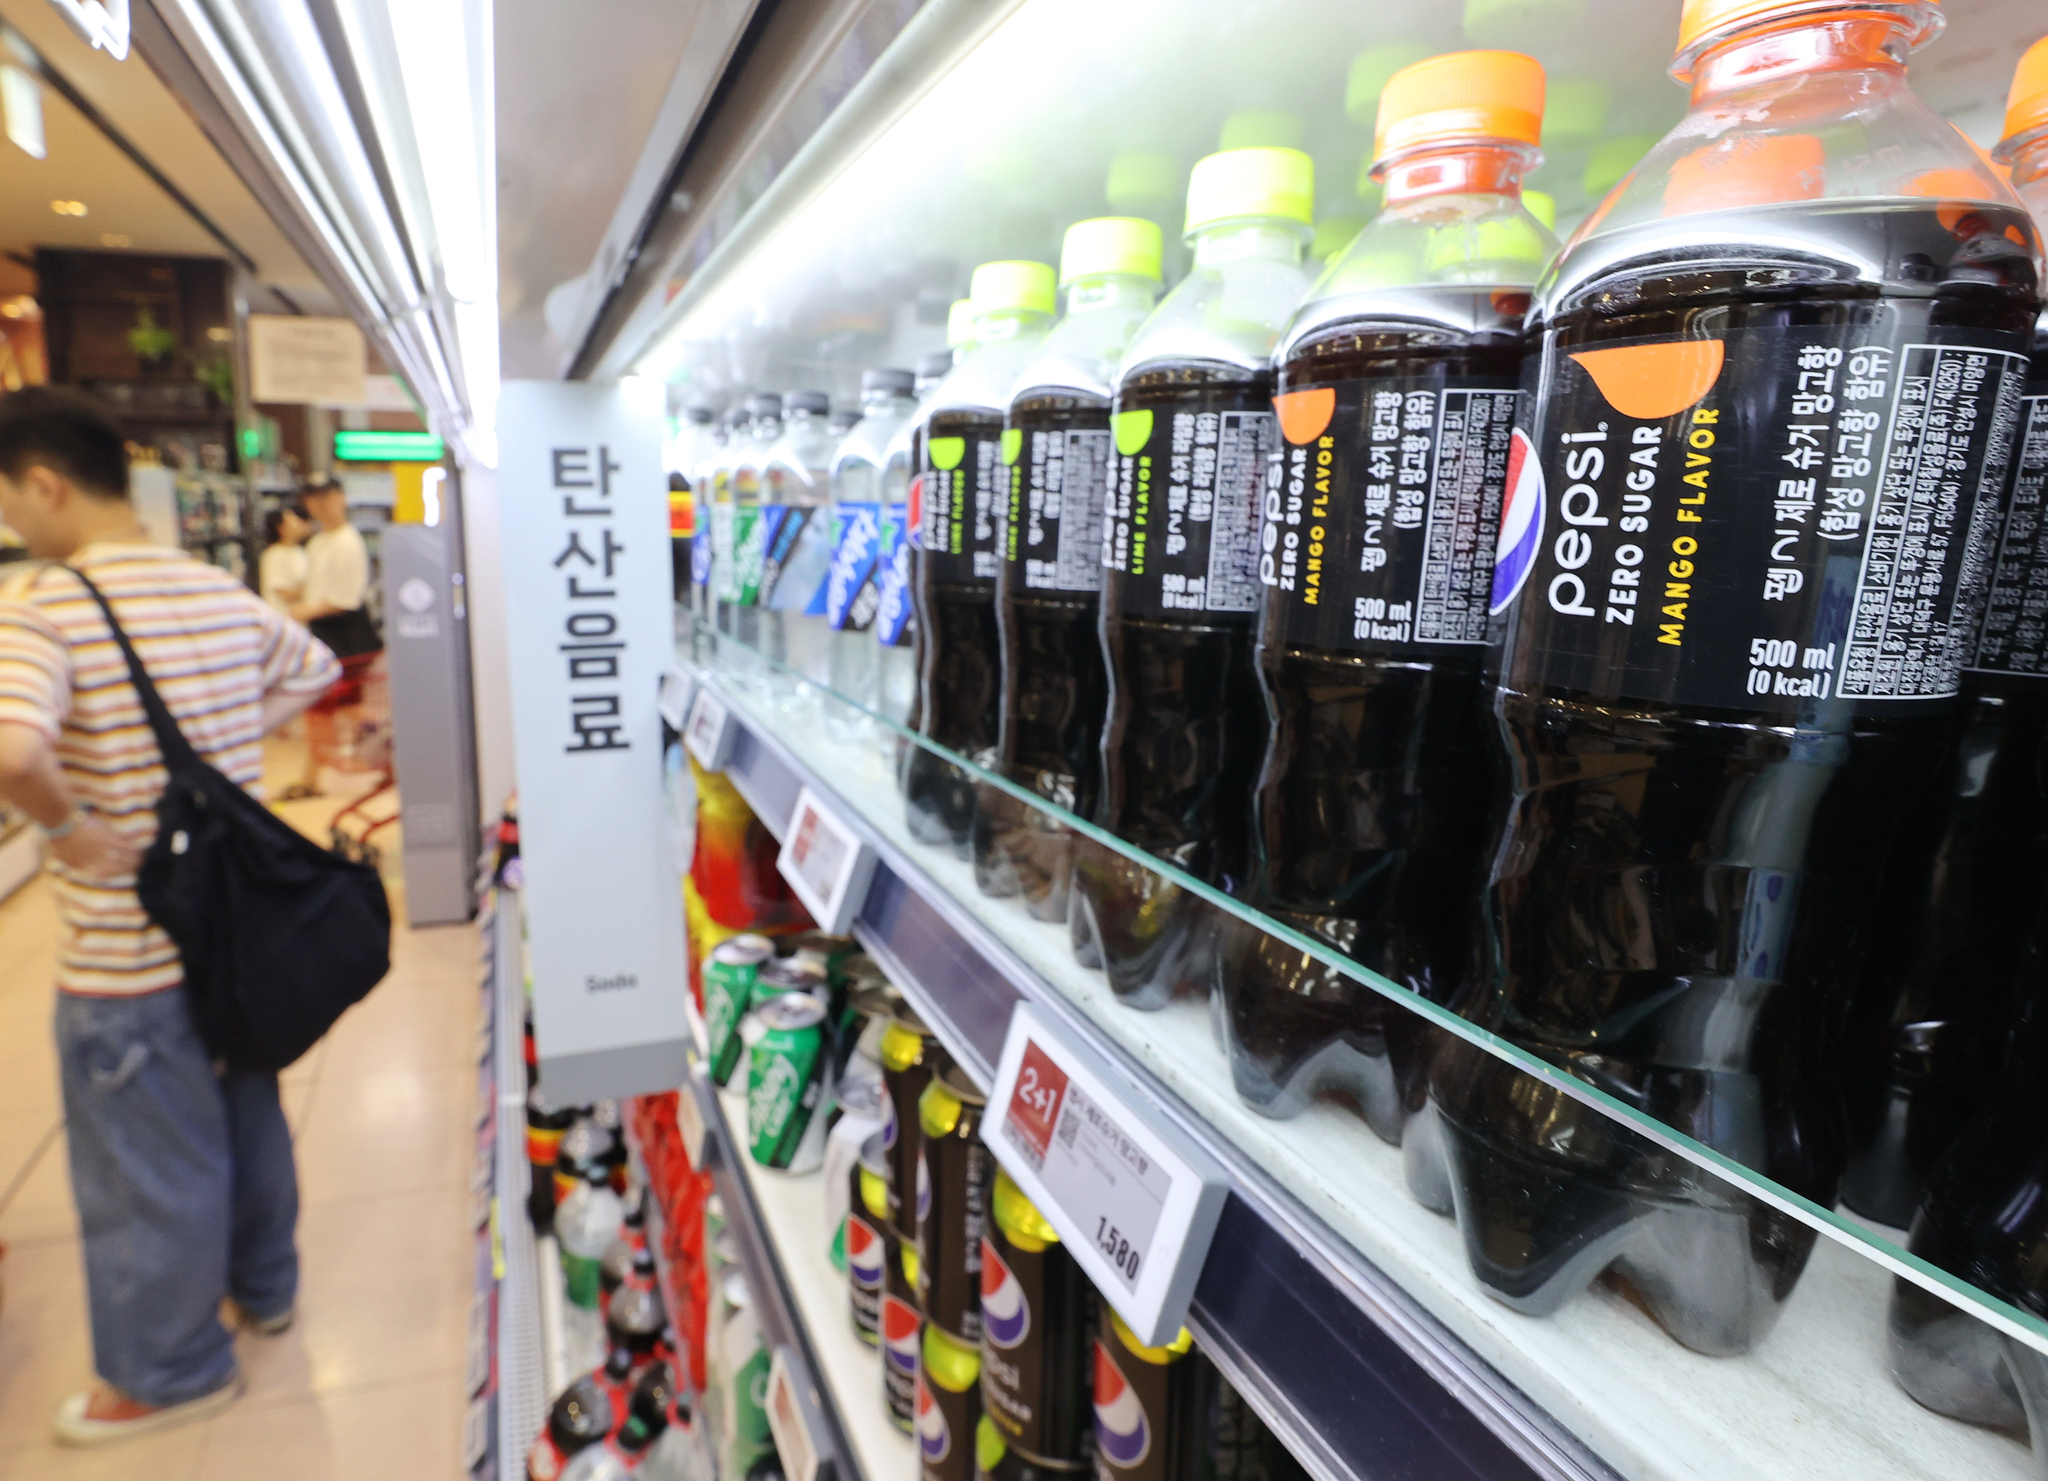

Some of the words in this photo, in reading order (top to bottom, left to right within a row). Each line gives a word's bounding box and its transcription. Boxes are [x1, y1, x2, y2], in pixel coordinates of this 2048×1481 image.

[1792, 345, 1842, 416] 망고향
[1843, 345, 1893, 405] 함유)
[1902, 375, 1932, 402] 표시
[1960, 353, 1989, 393] 미양면
[1371, 390, 1403, 442] 망고향
[1403, 389, 1437, 431] 함유)
[1894, 404, 1926, 443] 뚜껑에
[1952, 394, 1981, 433] 안성시
[1367, 445, 1398, 478] 슈거
[1398, 435, 1431, 485] 망고향
[1677, 407, 1720, 524] FLAVOR
[1782, 421, 1830, 472] 슈거
[1831, 409, 1880, 481] 망고향
[1888, 445, 1918, 471] 또는
[1944, 435, 1971, 472] 경기도
[1134, 455, 1152, 526] FLAVOR
[1286, 448, 1308, 526] SUGAR
[1312, 435, 1335, 518] FLAVOR
[1363, 483, 1391, 517] 제로
[1624, 426, 1663, 534] SUGAR
[1771, 475, 1817, 525] 제로
[1882, 473, 1912, 500] 상단
[1391, 488, 1426, 530] (합성
[1816, 483, 1866, 542] (합성
[1876, 502, 1906, 527] 용기
[1131, 531, 1147, 575] LIME
[1279, 530, 1300, 592] ZERO
[1303, 526, 1326, 606] MANGO
[1867, 535, 1900, 586] 소비기한
[1899, 535, 1929, 572] 뚜껑에
[551, 444, 631, 757] 탄산음료
[1354, 596, 1386, 620] 500
[1387, 600, 1412, 621] ml
[1605, 543, 1645, 626] ZERO
[1656, 534, 1699, 648] MANGO
[1894, 573, 1921, 600] 또는
[1854, 591, 1887, 639] 탄산음료
[1889, 600, 1915, 627] 상단
[1911, 598, 1937, 634] 대덕구
[1932, 620, 1948, 633] 17
[1748, 638, 1798, 670] 500
[1801, 641, 1835, 671] ml
[1882, 628, 1909, 653] 용기
[1747, 671, 1771, 697] (0
[1773, 672, 1831, 700] kcal)
[1843, 645, 1877, 694] 식품유형
[1873, 658, 1901, 695] 제조원
[1898, 637, 1929, 695] 대전광역시
[1019, 1066, 1057, 1123] 2+1
[1096, 1214, 1140, 1281] 1,580
